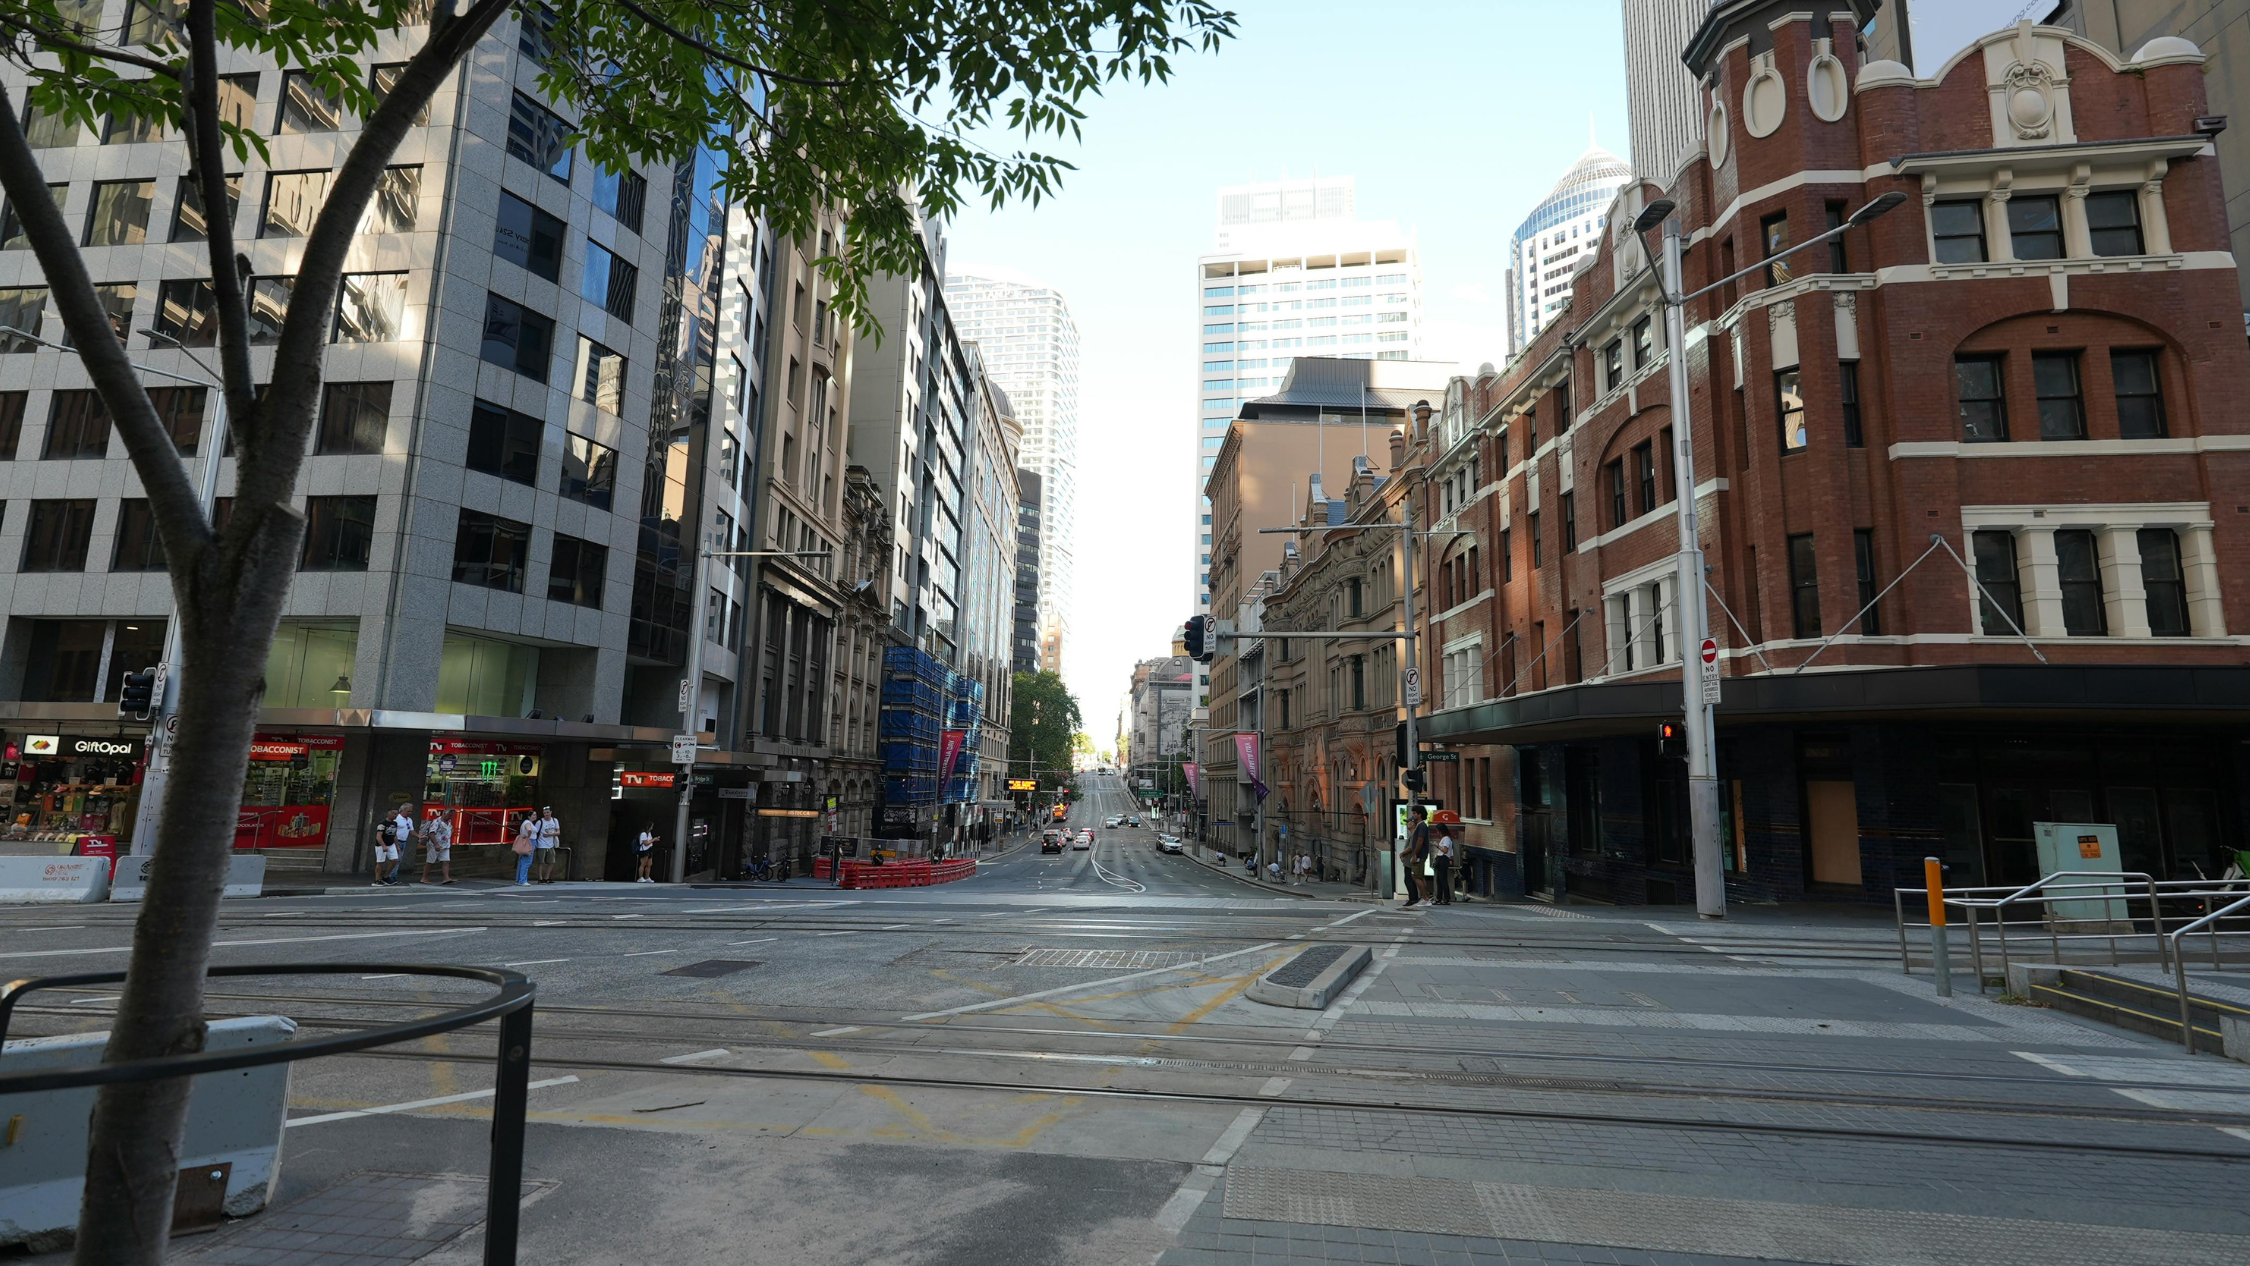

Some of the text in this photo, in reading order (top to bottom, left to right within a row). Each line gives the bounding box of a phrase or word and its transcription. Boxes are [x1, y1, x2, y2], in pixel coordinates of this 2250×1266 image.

[74, 741, 132, 756] GiftOpal
[250, 745, 304, 755] OBACCONIST
[1427, 752, 1457, 763] George St
